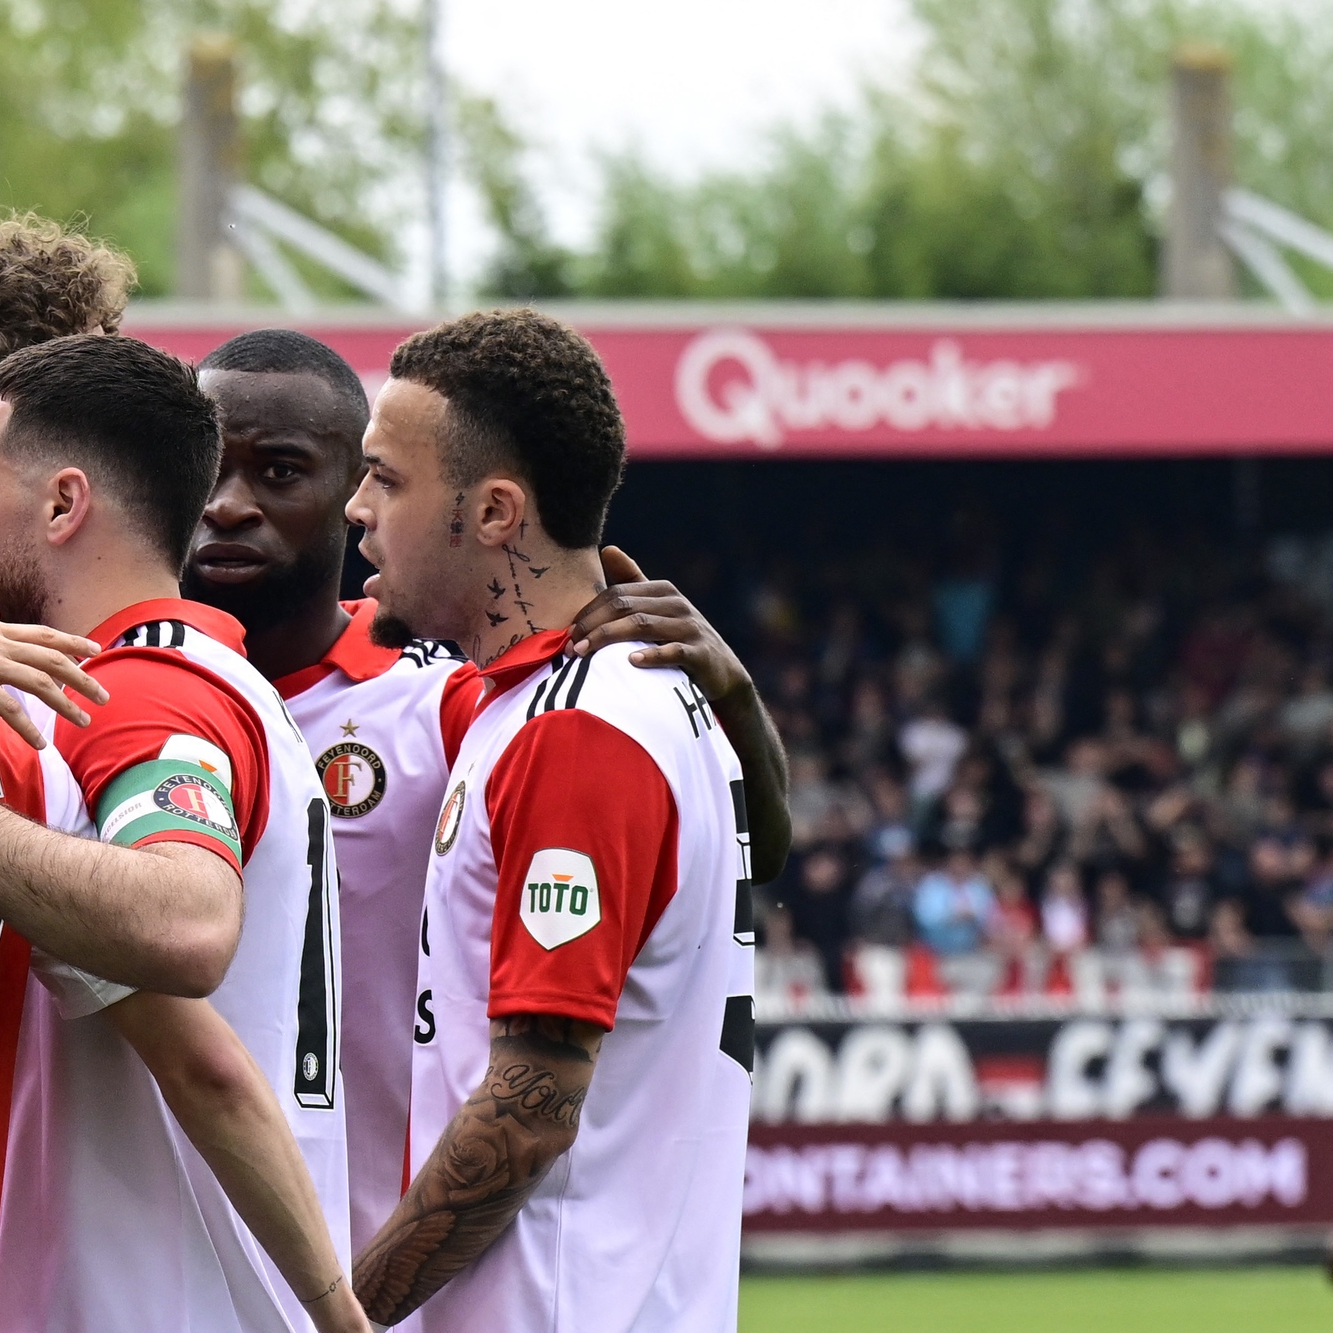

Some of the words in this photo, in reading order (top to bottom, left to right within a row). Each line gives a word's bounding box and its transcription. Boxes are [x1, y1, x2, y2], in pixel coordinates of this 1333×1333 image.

[674, 325, 1090, 450] Quooker
[318, 744, 382, 770] FEYENOORD
[527, 882, 589, 916] TOTO
